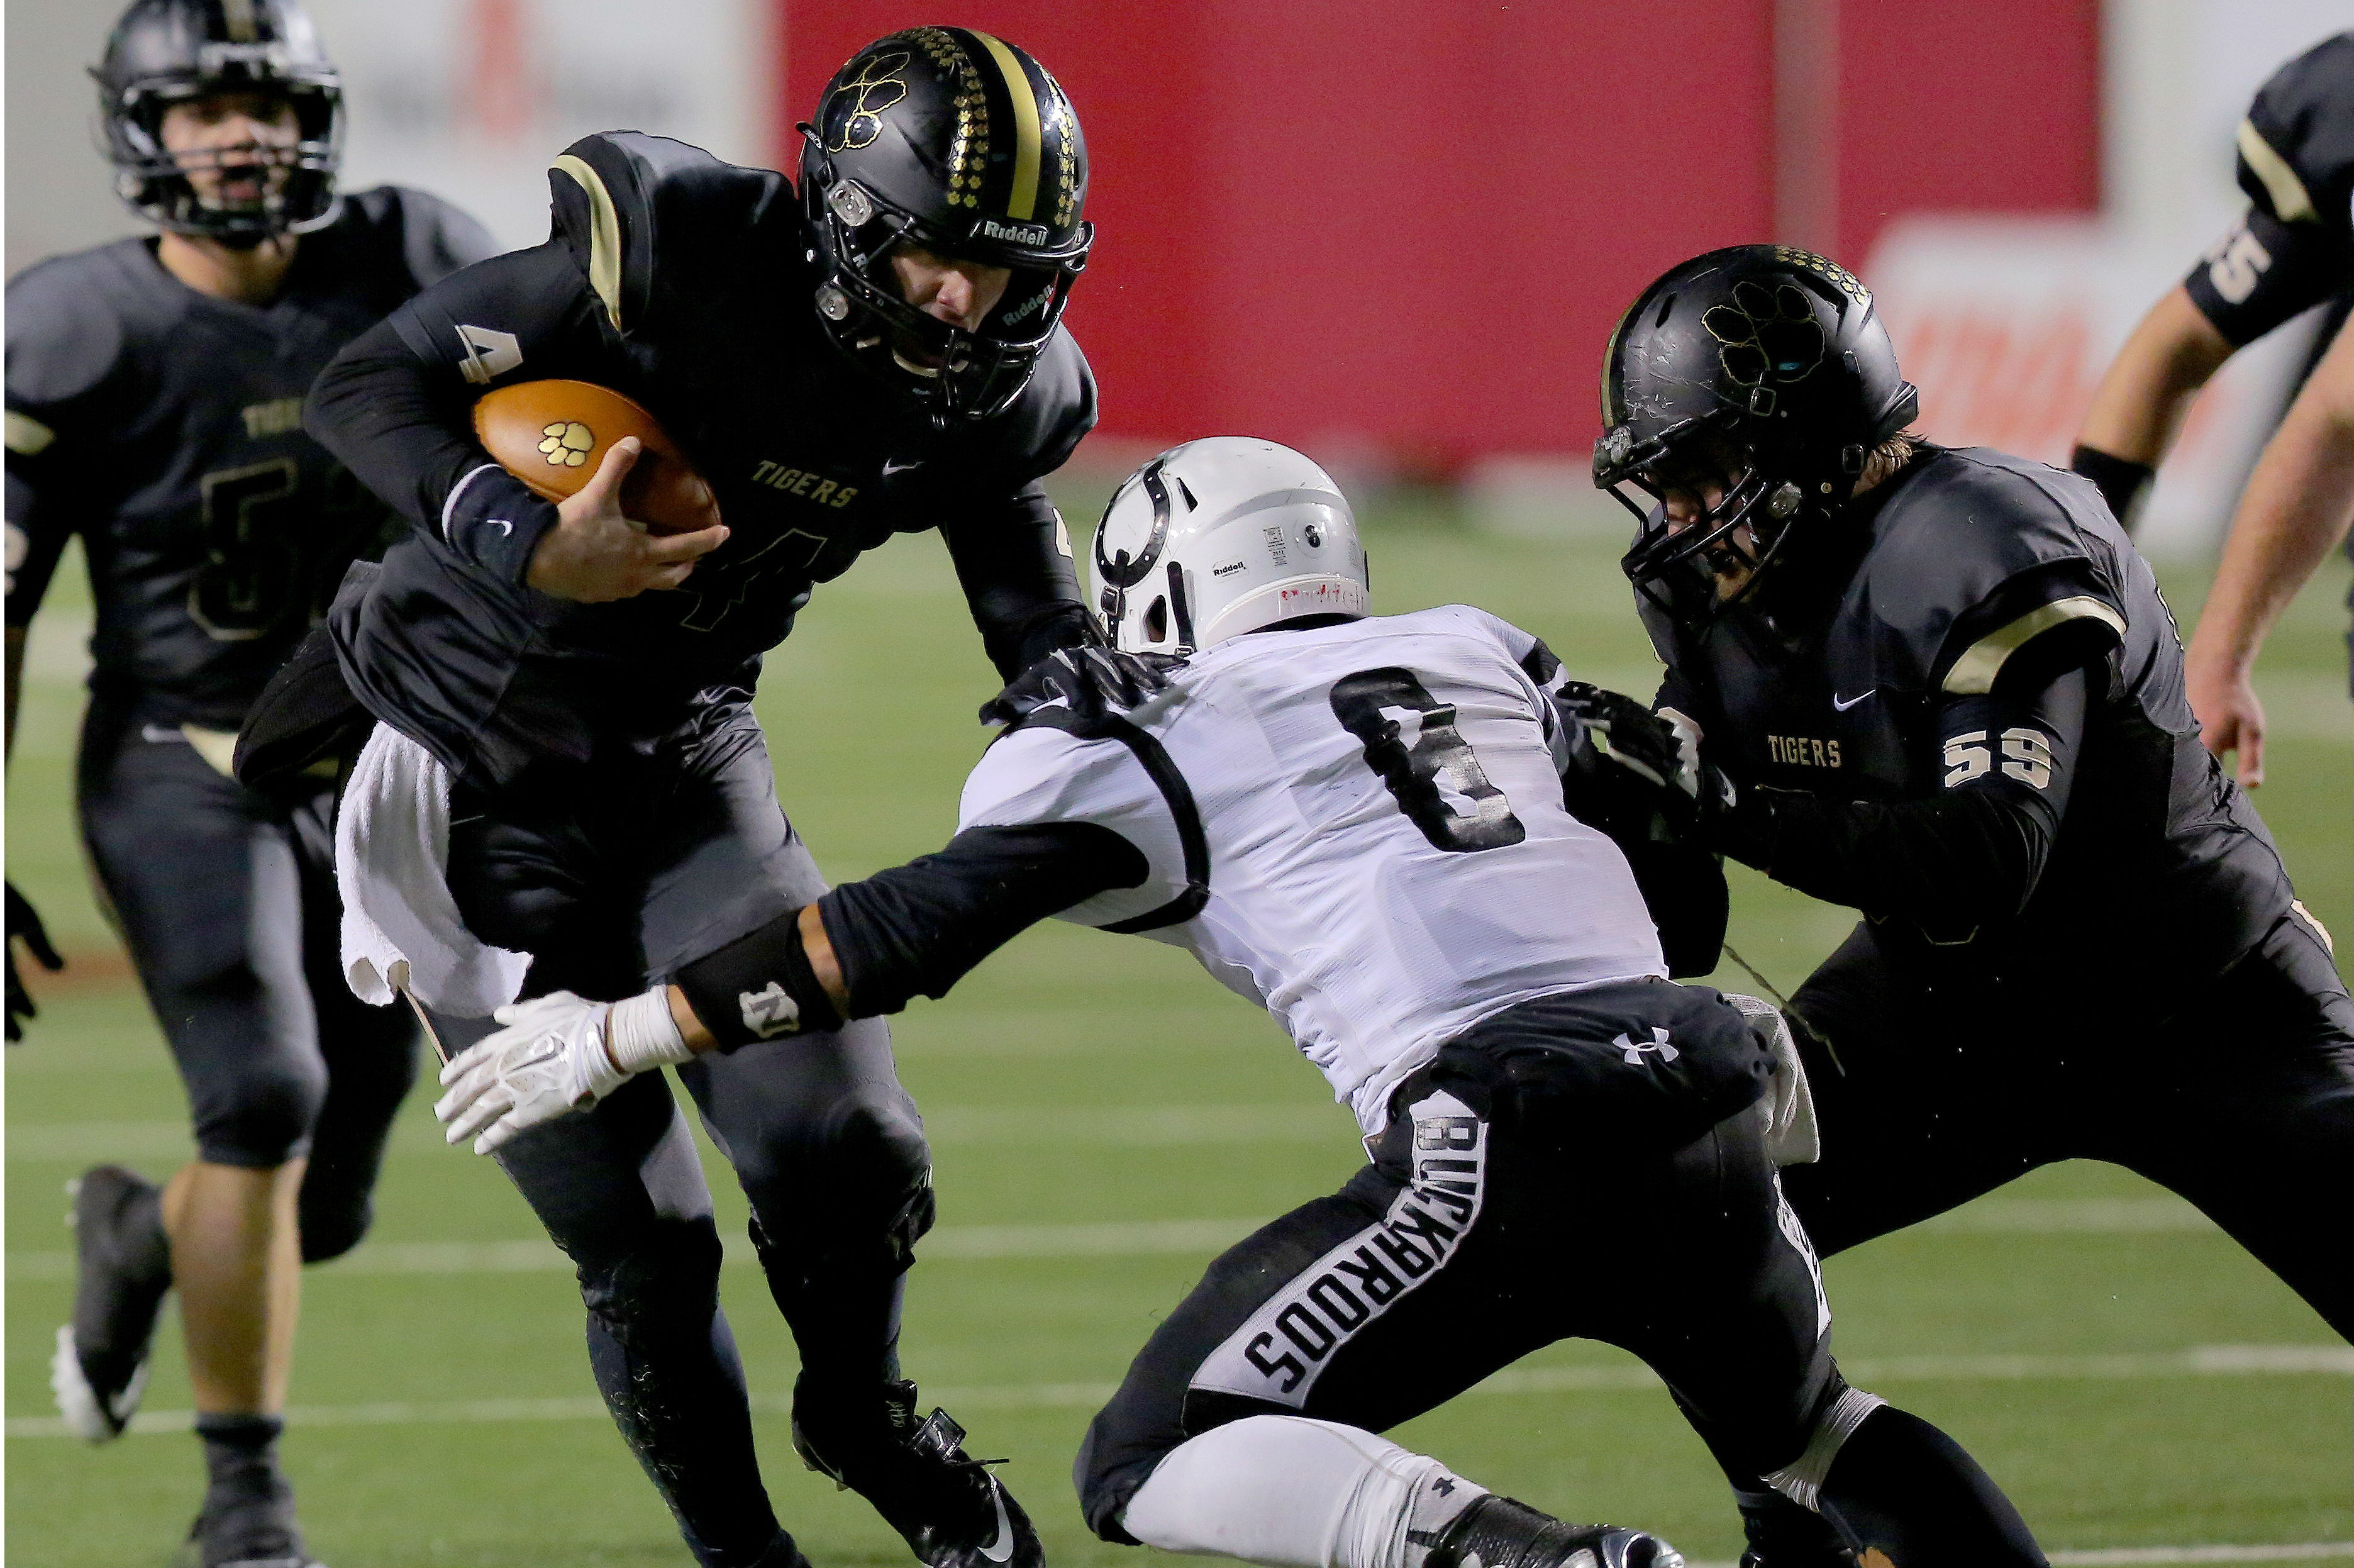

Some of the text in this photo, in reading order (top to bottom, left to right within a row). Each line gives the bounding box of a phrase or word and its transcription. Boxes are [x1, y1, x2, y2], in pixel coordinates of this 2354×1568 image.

[984, 221, 1047, 246] Riddell
[751, 459, 859, 508] TIGERS
[1213, 562, 1244, 576] Riddell
[1768, 735, 1842, 768] TIGERS
[1943, 728, 2053, 790] 59
[1245, 1115, 1479, 1394] BUCKAROOS
